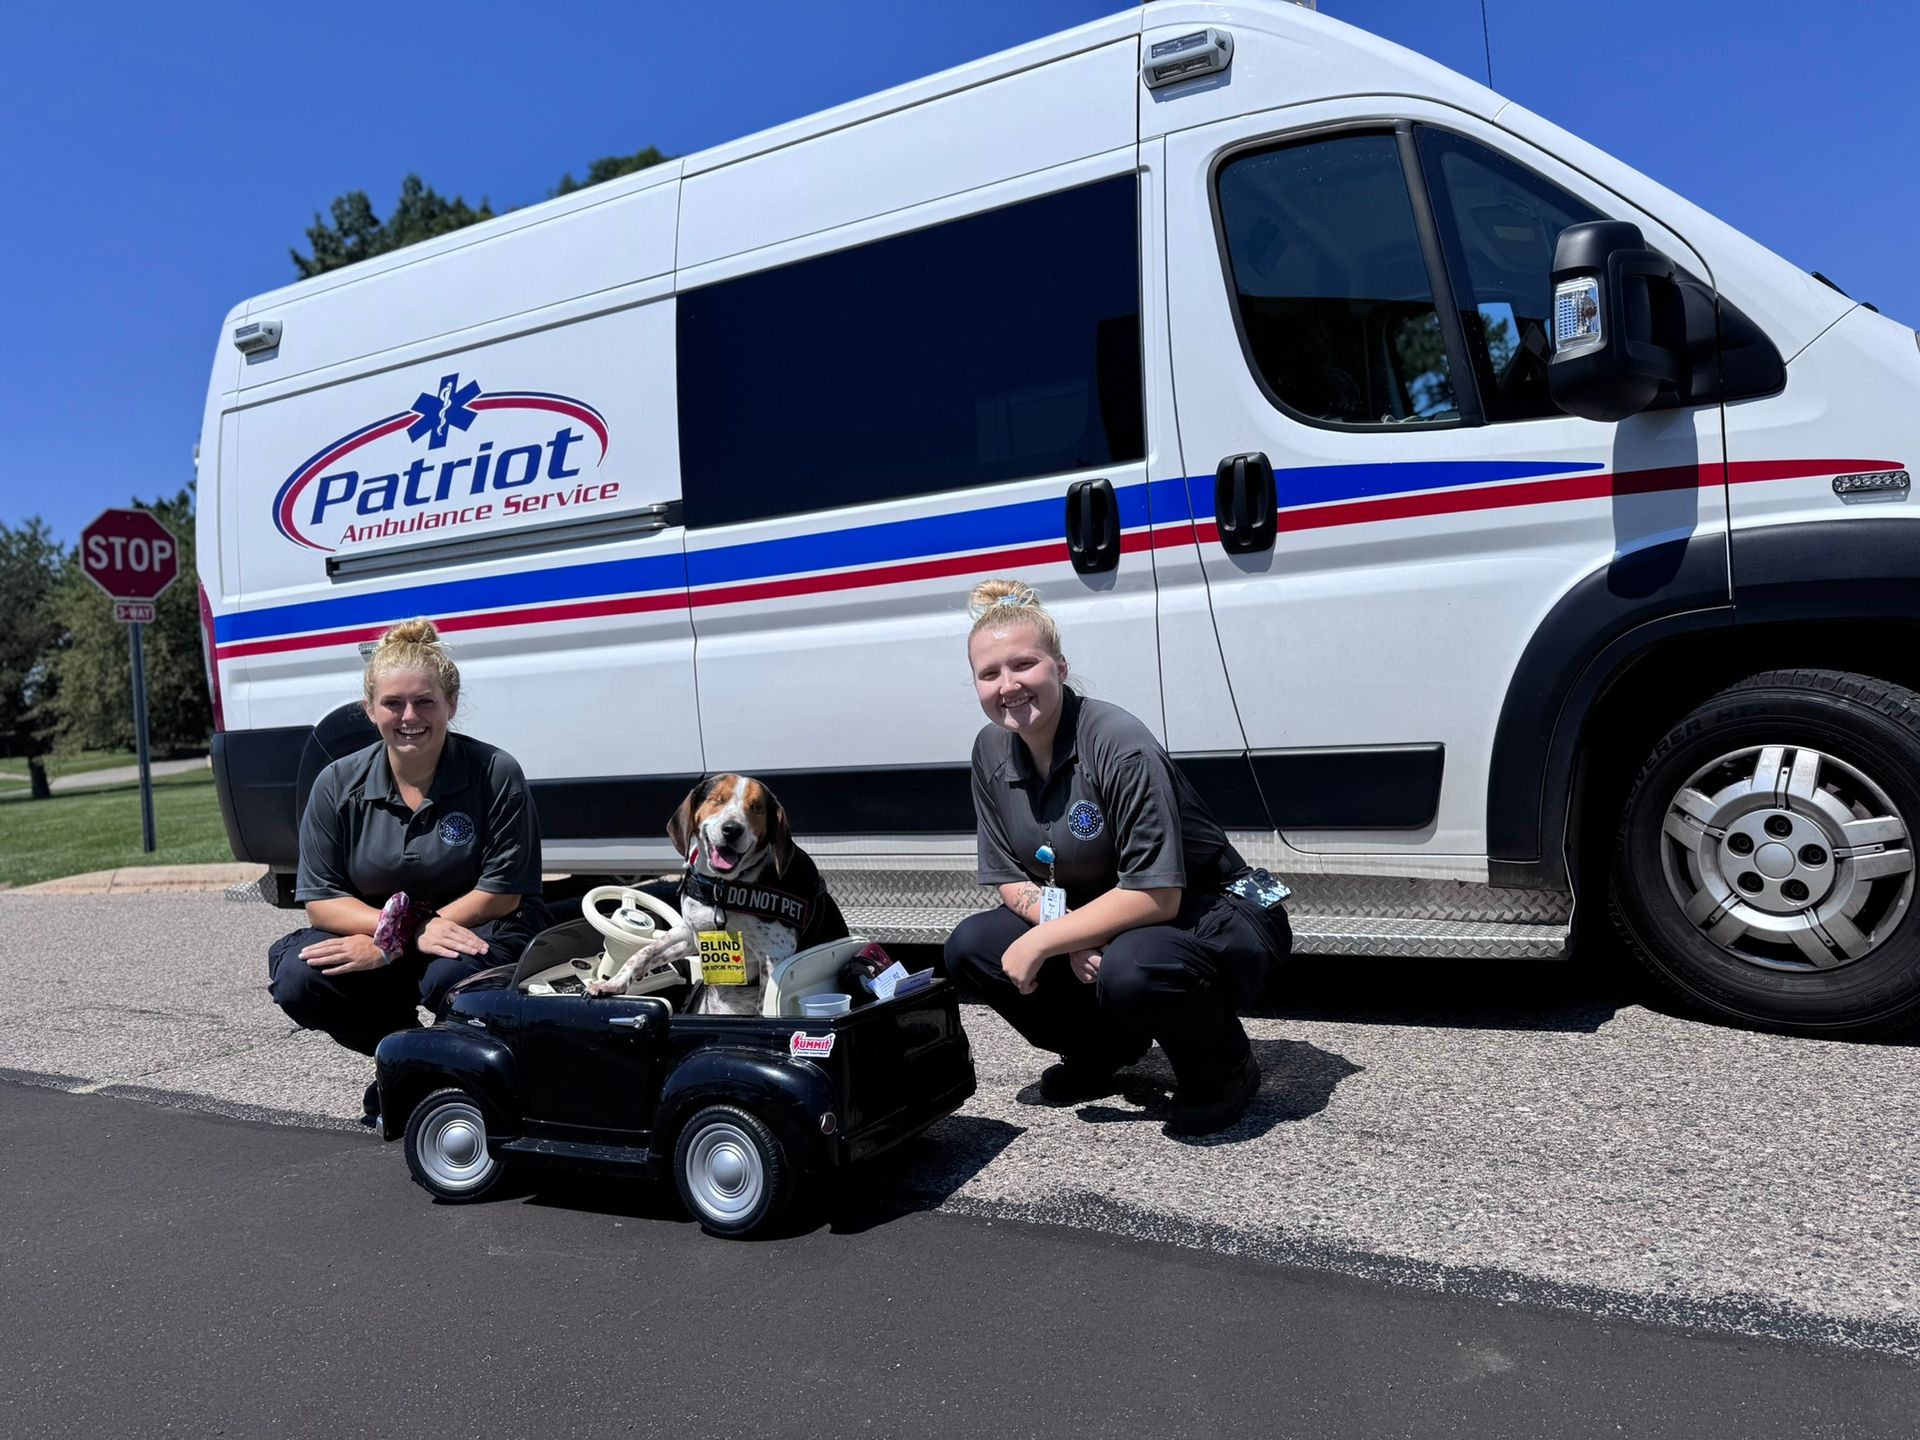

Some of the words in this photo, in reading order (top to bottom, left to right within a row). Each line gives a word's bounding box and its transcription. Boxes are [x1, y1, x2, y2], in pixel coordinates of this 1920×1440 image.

[310, 427, 584, 525] Patriot
[339, 504, 493, 544] Ambulance
[502, 482, 620, 516] Service
[88, 535, 172, 572] STOP
[727, 886, 748, 906] DO
[749, 889, 779, 912] NOT
[781, 897, 803, 920] PET
[700, 941, 740, 951] BLIND
[701, 953, 730, 963] DOG
[793, 1034, 831, 1050] SUMMIT
